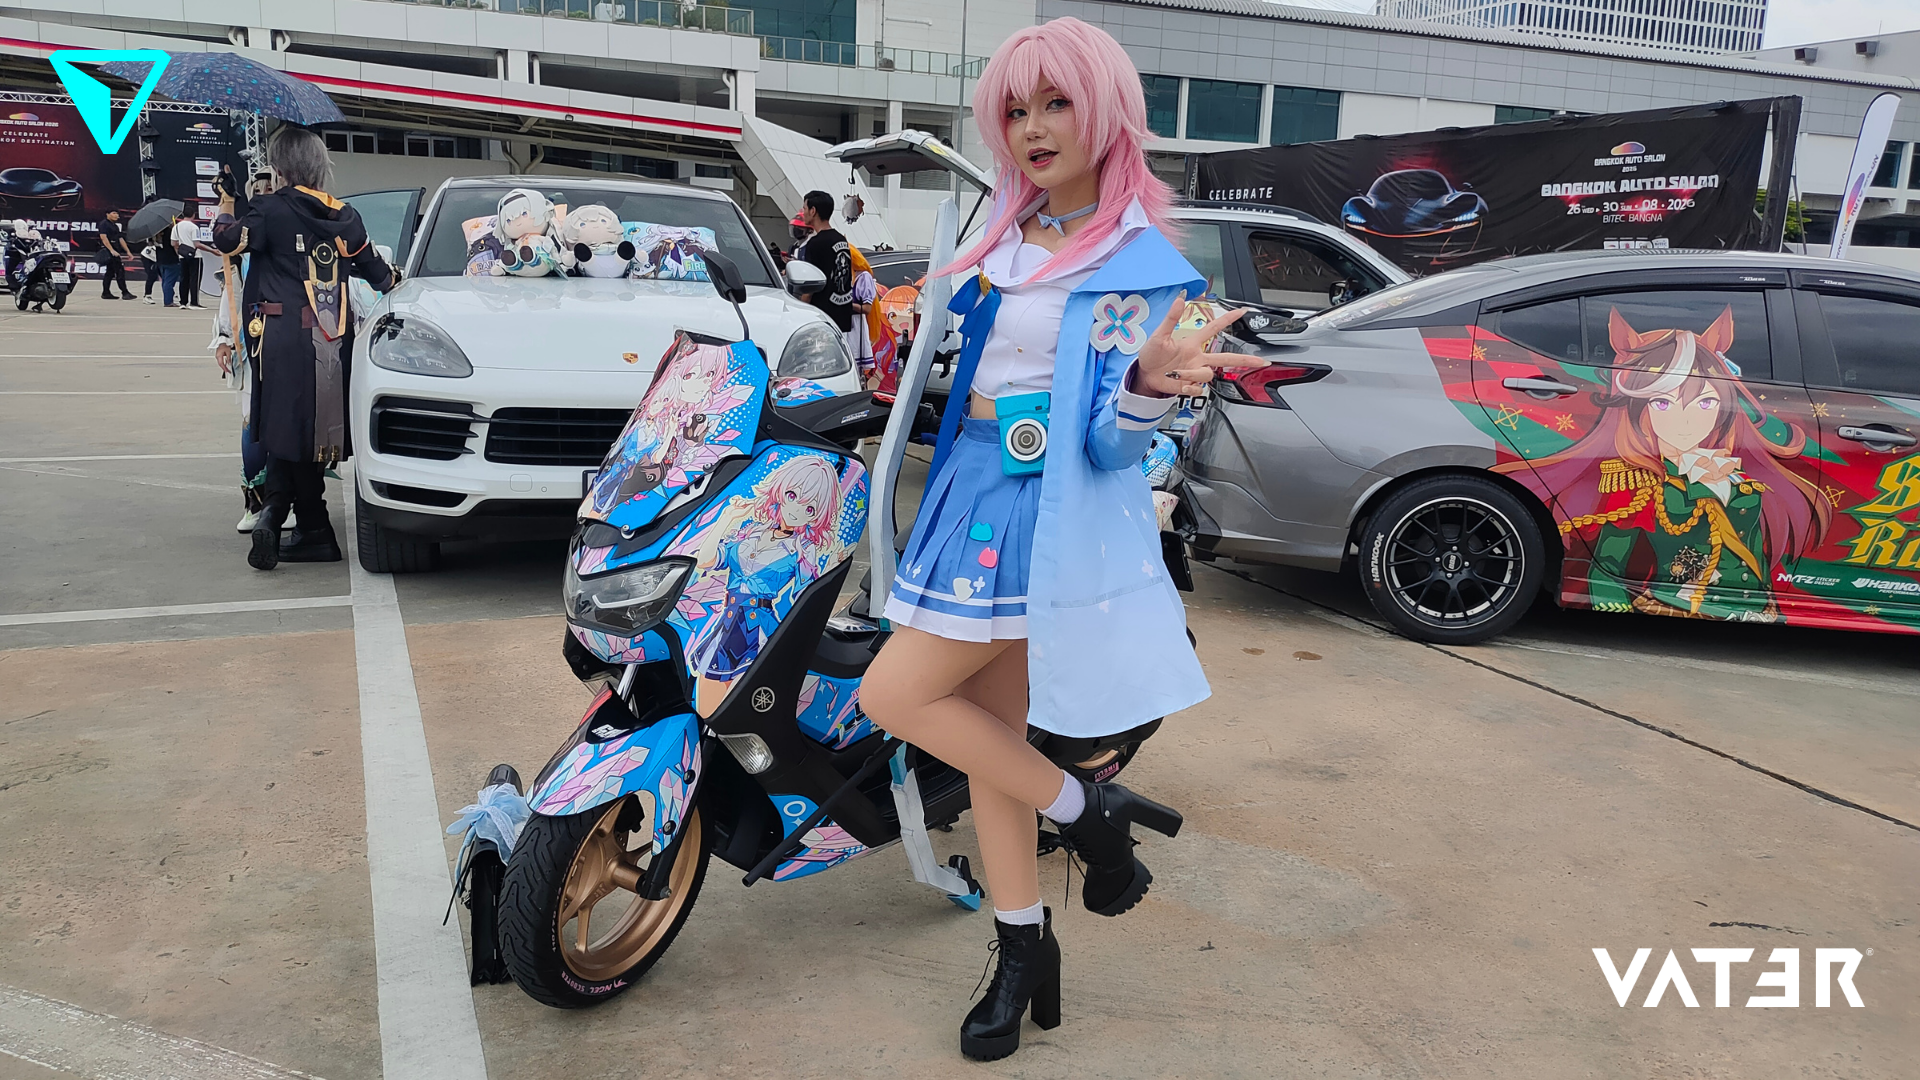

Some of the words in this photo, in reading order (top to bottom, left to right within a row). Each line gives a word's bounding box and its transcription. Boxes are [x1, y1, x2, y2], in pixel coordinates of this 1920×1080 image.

[1594, 157, 1624, 167] BANGKOK
[1625, 155, 1643, 164] AUTO
[1644, 153, 1666, 162] SALON
[1541, 182, 1616, 197] BANGKOK
[1619, 178, 1665, 192] AUTO
[1668, 174, 1719, 189] SALON
[1208, 187, 1273, 200] CELEBRATE
[1567, 203, 1581, 215] 26
[1602, 201, 1619, 212] 30
[1642, 199, 1658, 210] 08
[1667, 198, 1695, 210] 2026
[1603, 214, 1625, 223] BITEC
[1628, 213, 1663, 222] BANGNA
[1867, 579, 1920, 592] Hanko
